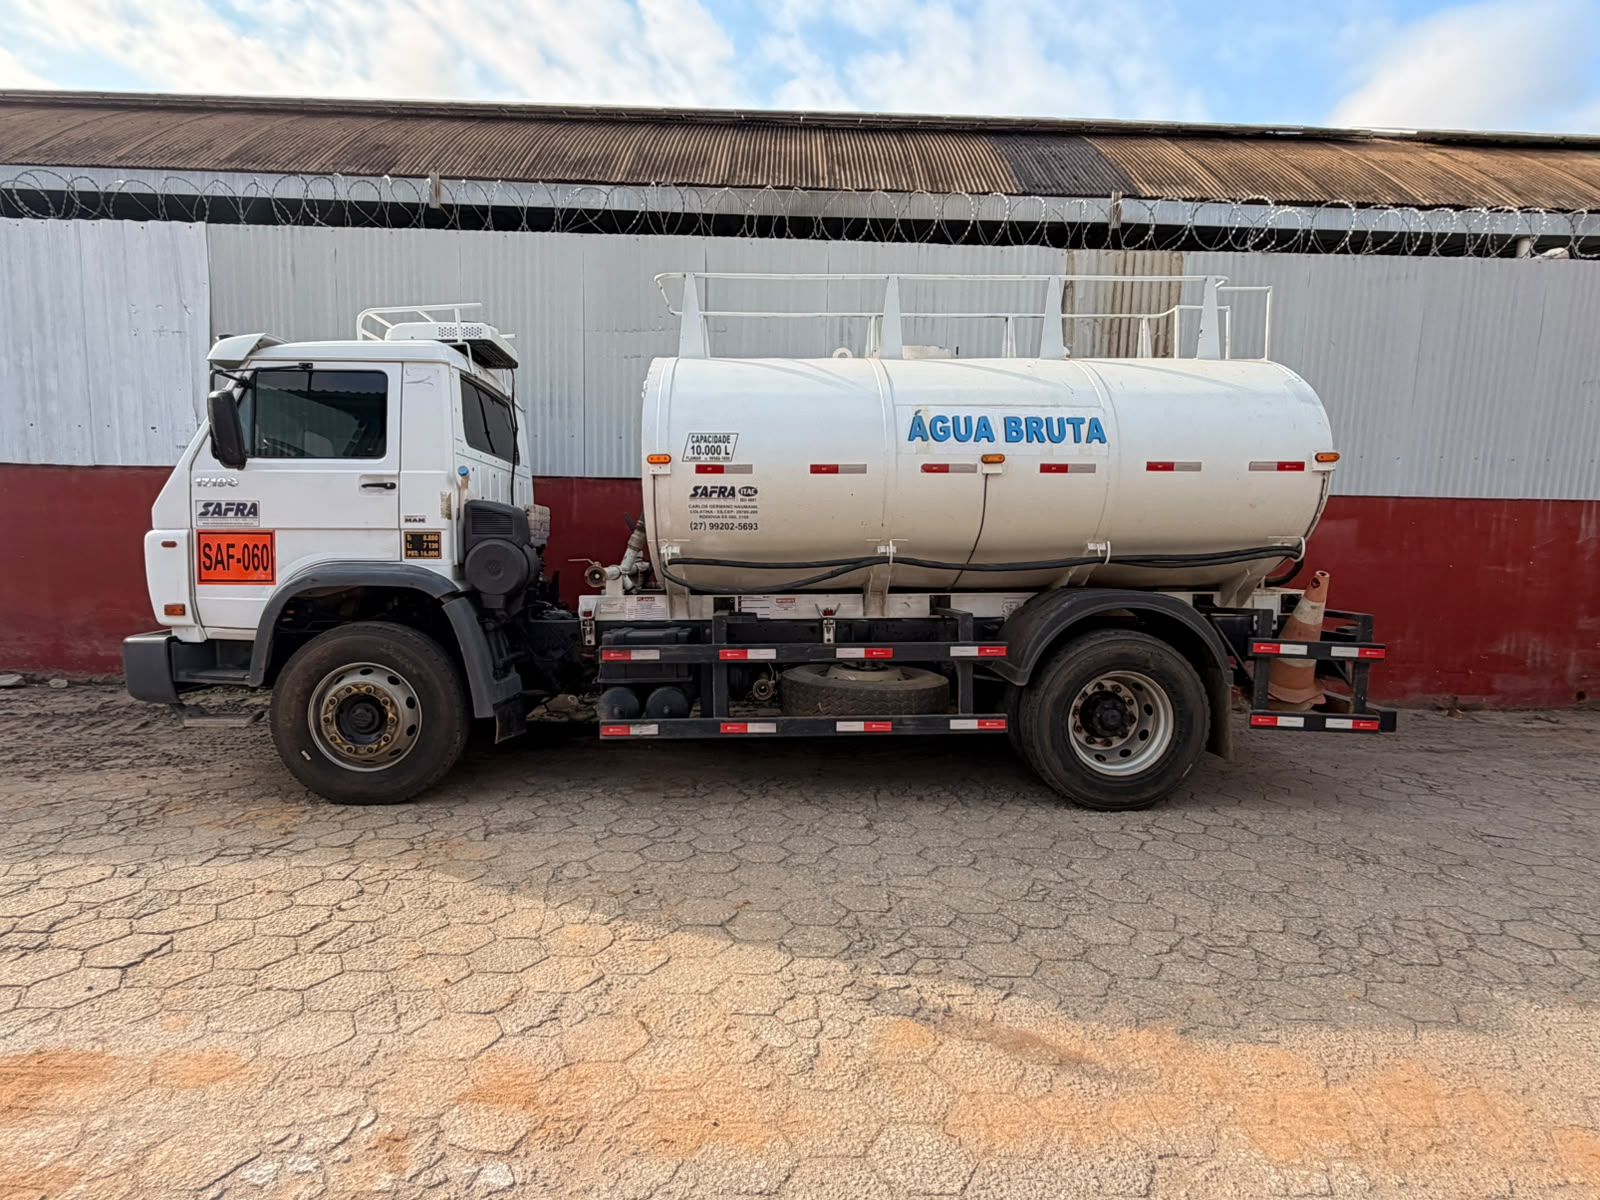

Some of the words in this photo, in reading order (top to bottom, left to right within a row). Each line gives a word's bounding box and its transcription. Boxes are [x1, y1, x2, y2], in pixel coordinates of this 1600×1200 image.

[908, 409, 995, 443] ÁGUA
[1003, 416, 1107, 444] BRUTA
[691, 435, 731, 444] CAPACIDADE
[691, 445, 722, 455] 10.000
[724, 445, 730, 455] L
[690, 486, 736, 497] SAFRA
[198, 502, 258, 516] SAFRA
[690, 521, 707, 531] (27)
[709, 522, 758, 531] 99202-5693
[203, 543, 269, 571] SAF-060
